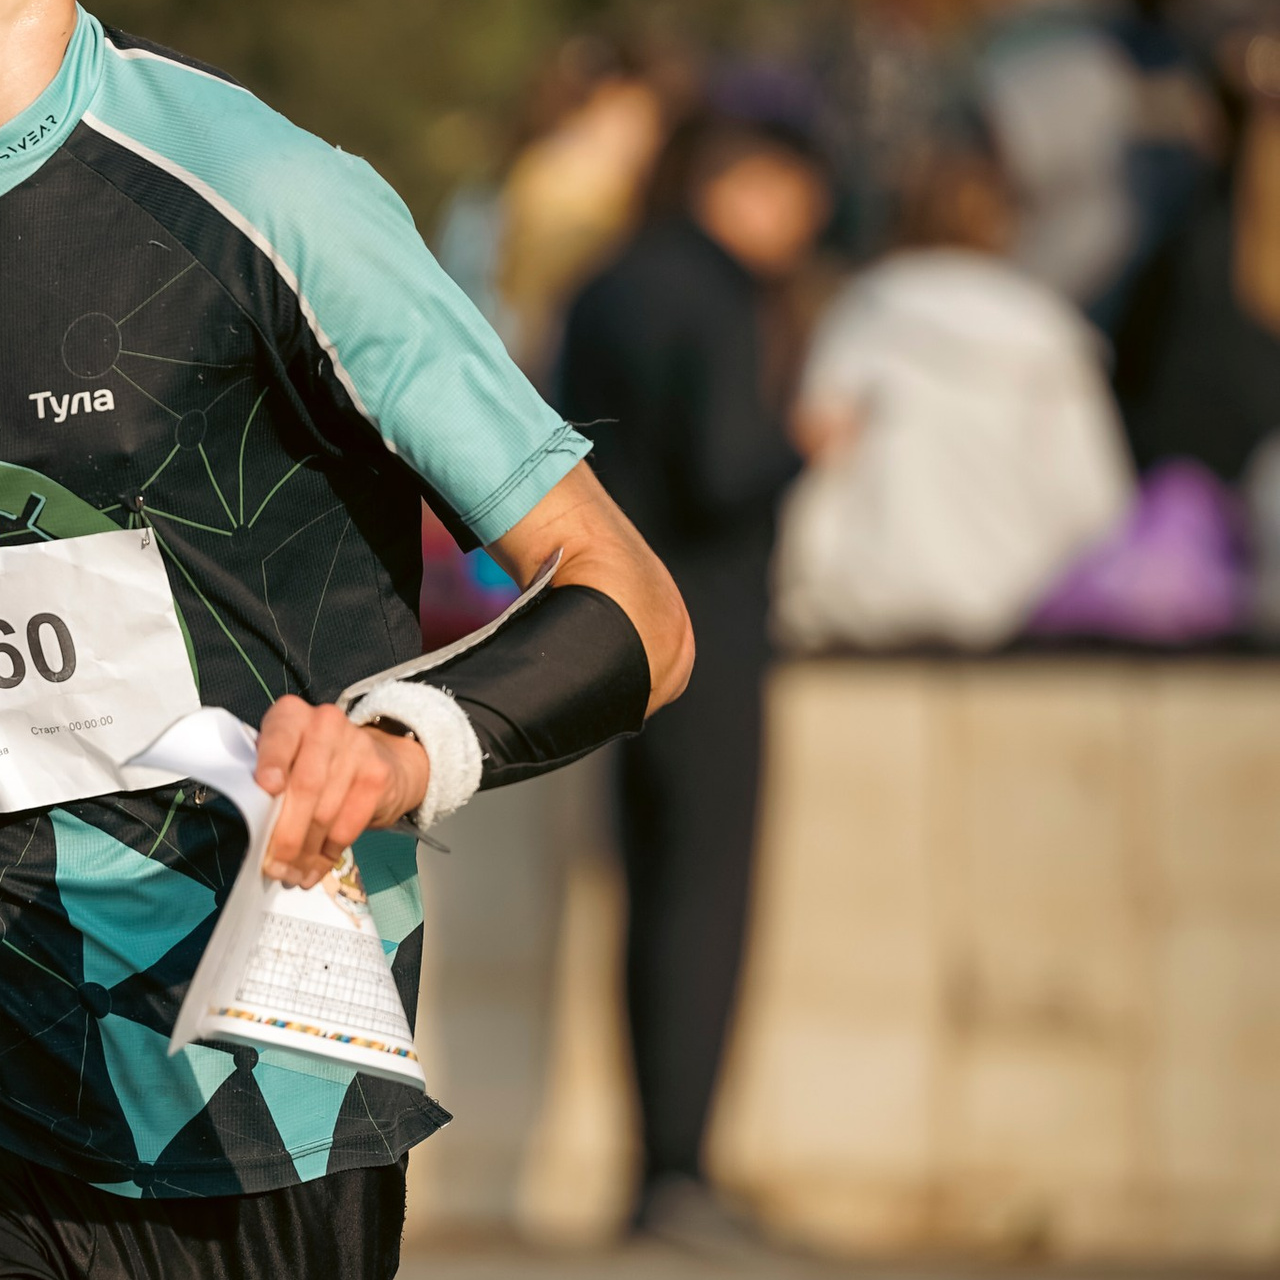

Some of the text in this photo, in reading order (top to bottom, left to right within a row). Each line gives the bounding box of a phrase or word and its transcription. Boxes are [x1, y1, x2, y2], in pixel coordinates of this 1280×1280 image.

[28, 388, 115, 423] Тула
[30, 725, 61, 735] Старт
[68, 715, 114, 732] 00:00:00
